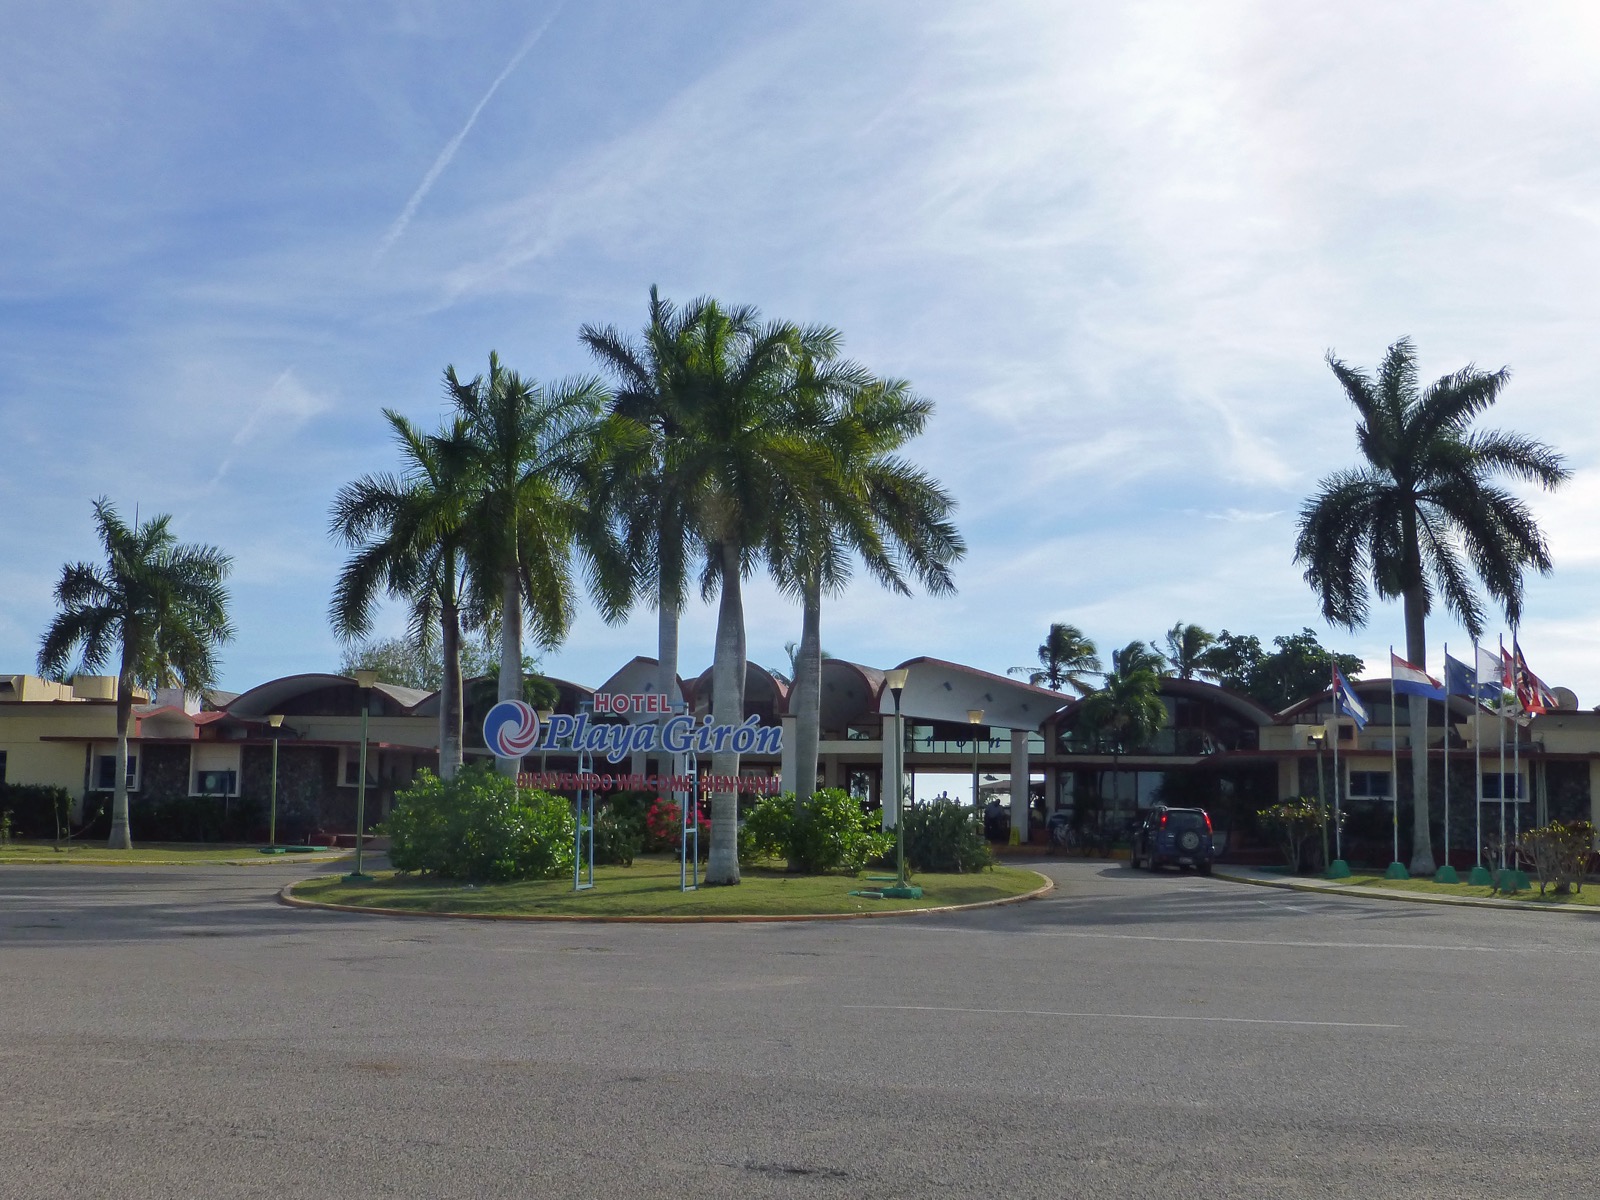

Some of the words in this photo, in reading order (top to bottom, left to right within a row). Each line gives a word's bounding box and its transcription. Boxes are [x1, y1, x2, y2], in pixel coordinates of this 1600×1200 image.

[593, 693, 672, 714] HOTEL
[540, 712, 656, 763] Playa
[663, 713, 784, 754] Girón
[516, 772, 612, 791] BIENVENIDO
[616, 773, 693, 792] WELCOME
